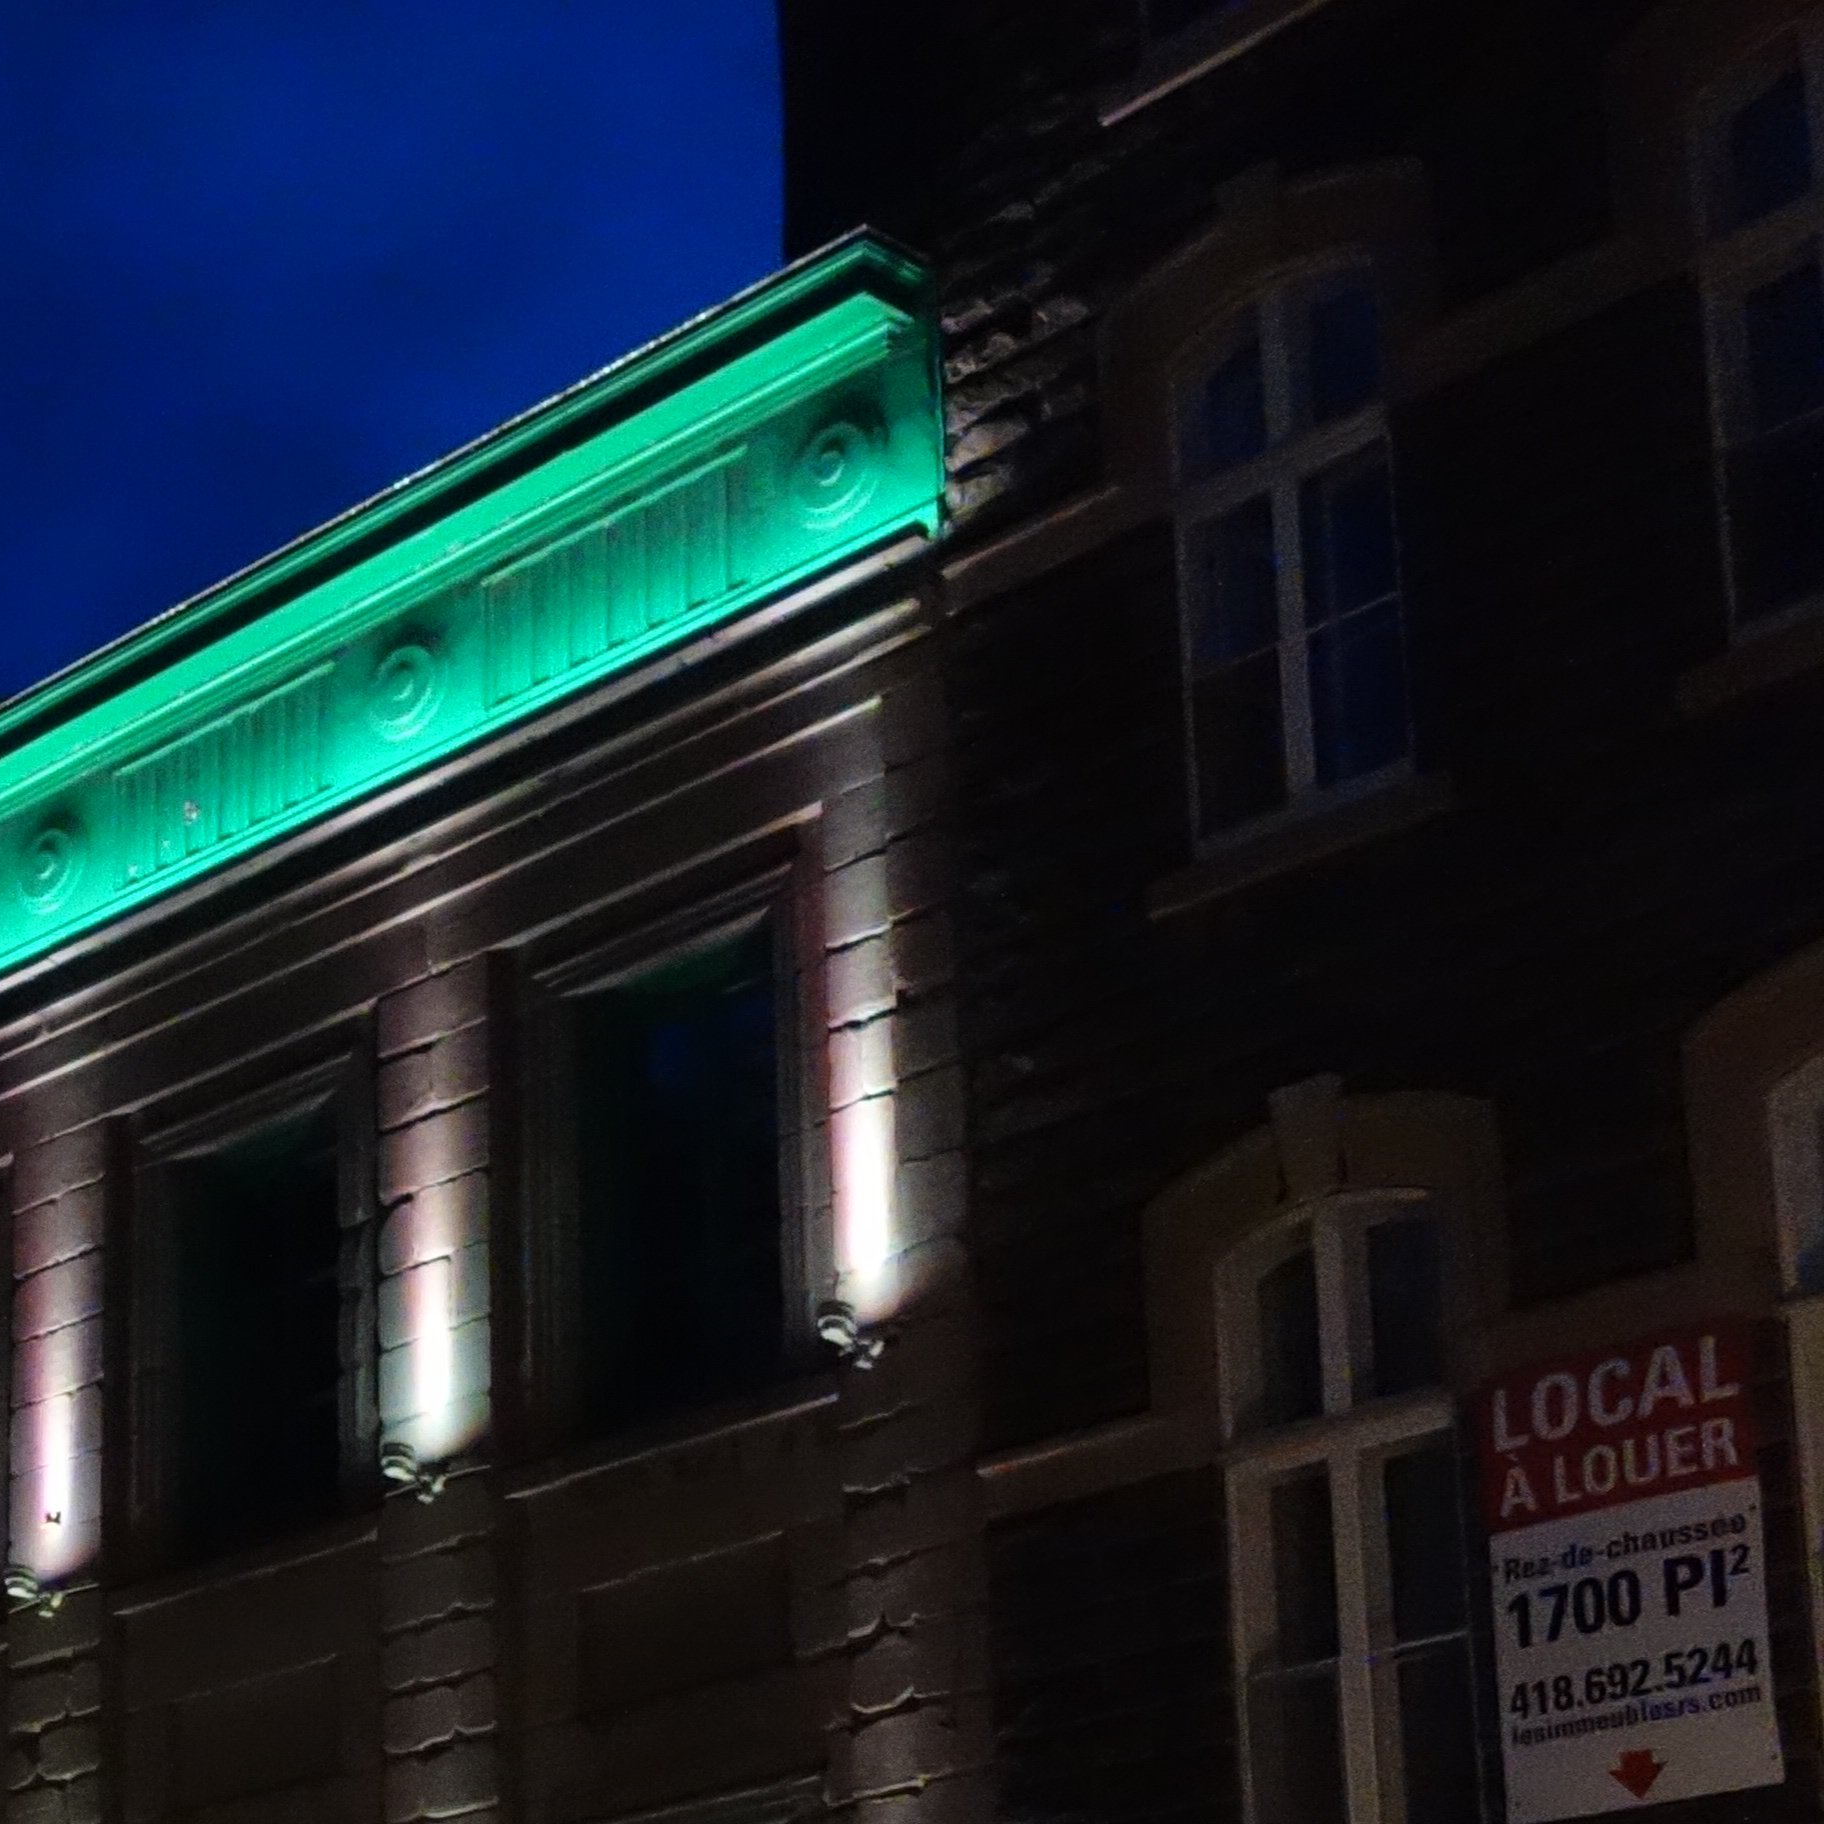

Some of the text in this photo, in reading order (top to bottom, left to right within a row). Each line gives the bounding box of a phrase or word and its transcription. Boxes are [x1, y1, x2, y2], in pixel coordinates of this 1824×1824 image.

[1492, 1335, 1743, 1453] LOCAL
[1499, 1417, 1739, 1518] À LOUER
[1508, 1569, 1641, 1648] 1700
[1510, 1639, 1757, 1720] 418.692.5244
